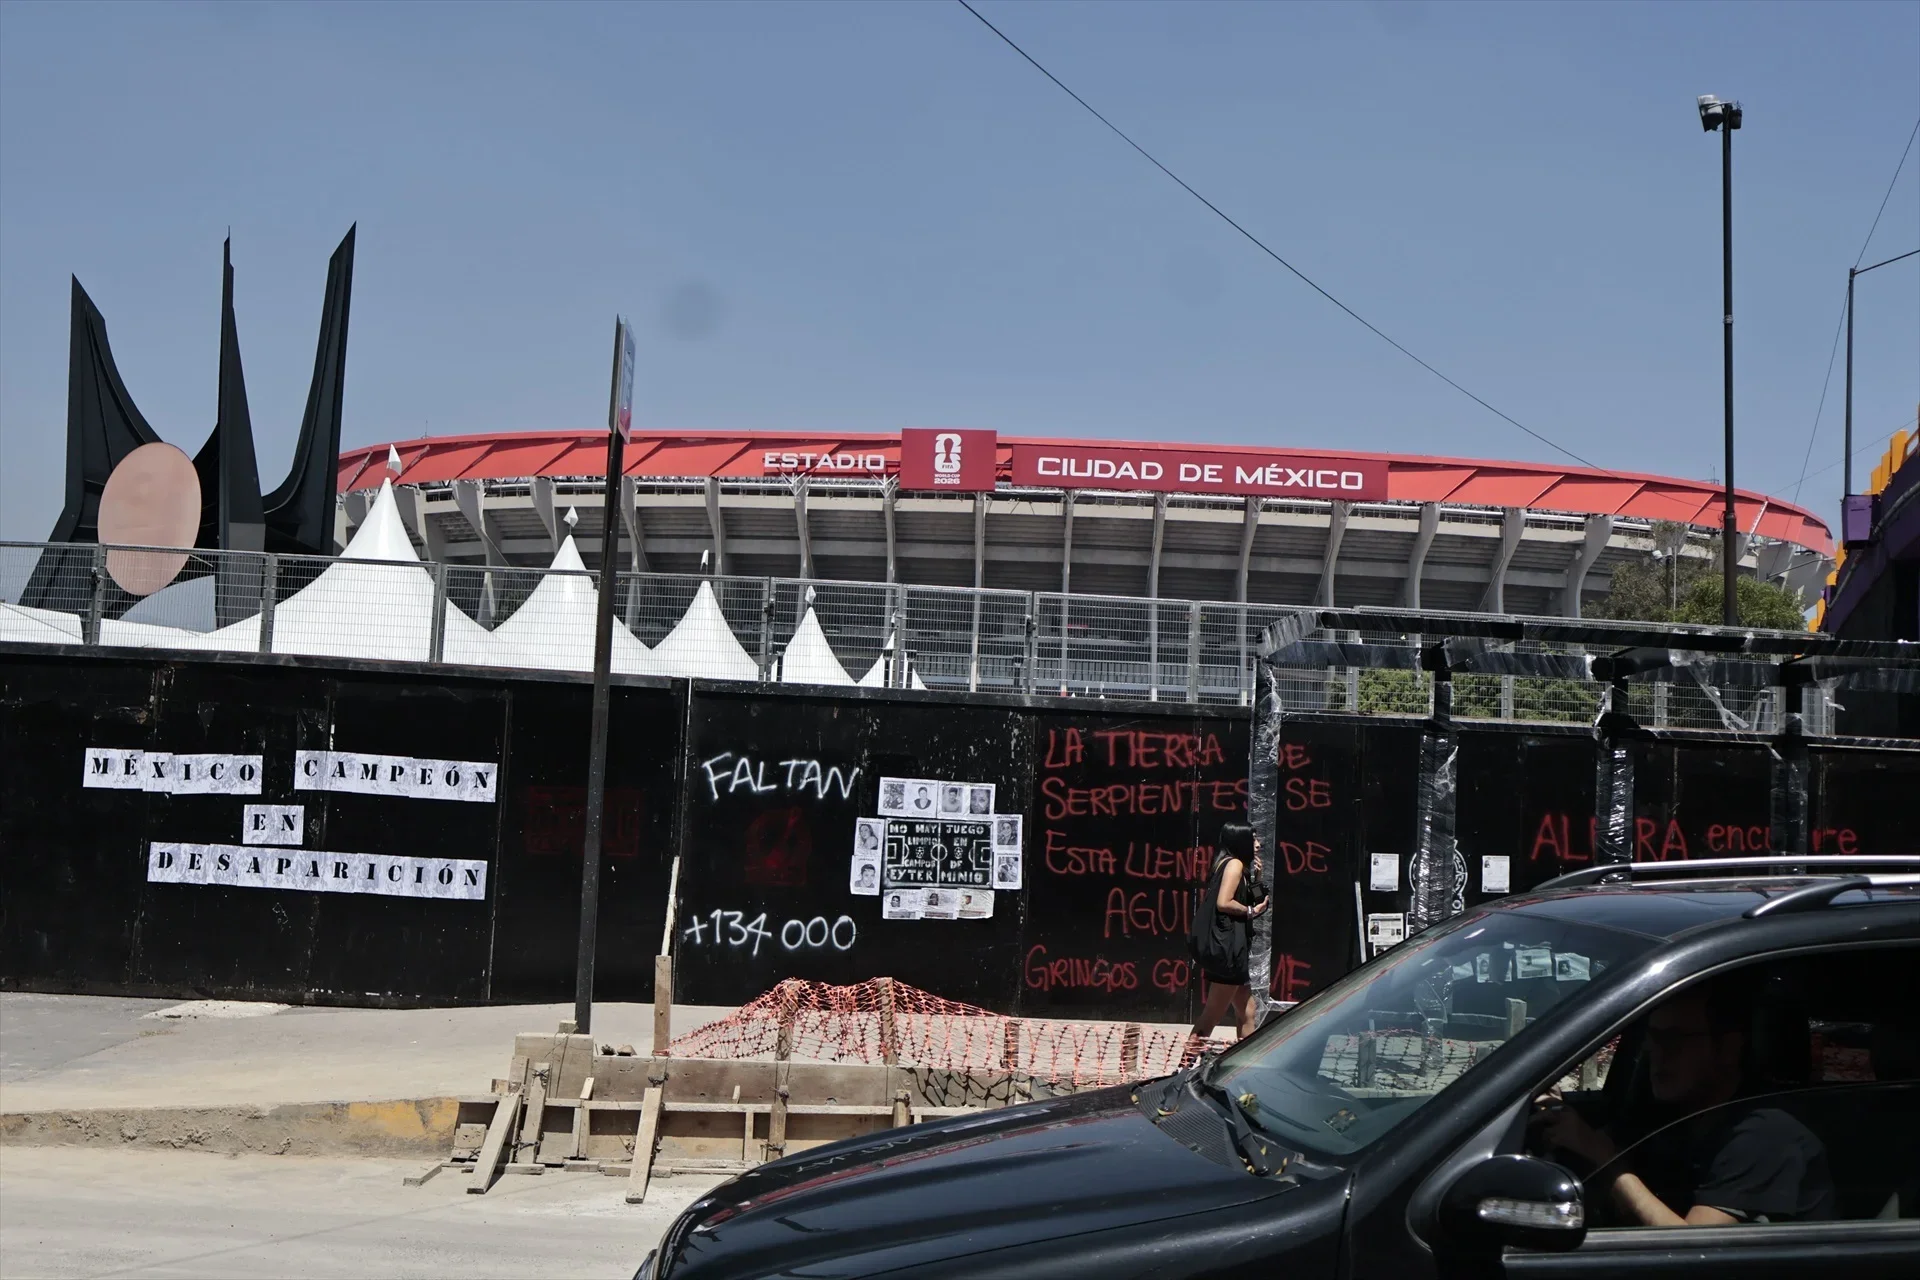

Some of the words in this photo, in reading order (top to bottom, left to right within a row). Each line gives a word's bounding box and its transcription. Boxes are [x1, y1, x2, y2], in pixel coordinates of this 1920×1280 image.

[764, 452, 885, 470] ESTADIO
[1037, 456, 1164, 481] CIUDAD
[1179, 463, 1223, 484] DE
[1235, 462, 1363, 491] MÉXICO
[1044, 727, 1084, 768] LA
[1093, 731, 1225, 768] TIERRA
[91, 754, 256, 782] MÉXICO
[303, 759, 490, 789] CAMPEÓN
[701, 752, 860, 800] FALTAN
[1286, 778, 1331, 810] SE
[252, 813, 296, 832] EN
[889, 824, 908, 834] NO
[915, 824, 937, 834] HAY
[946, 824, 984, 835] JUEGO
[907, 837, 939, 846] LIMPIO
[953, 837, 967, 847] EN
[1045, 829, 1117, 875] ESTA
[1280, 841, 1331, 874] DE
[157, 851, 480, 886] DESAPARICIÓN
[904, 859, 936, 868] CAMPOS
[684, 909, 773, 956] +134
[1025, 944, 1138, 993] GRINGOS
[1152, 958, 1190, 994] GO
